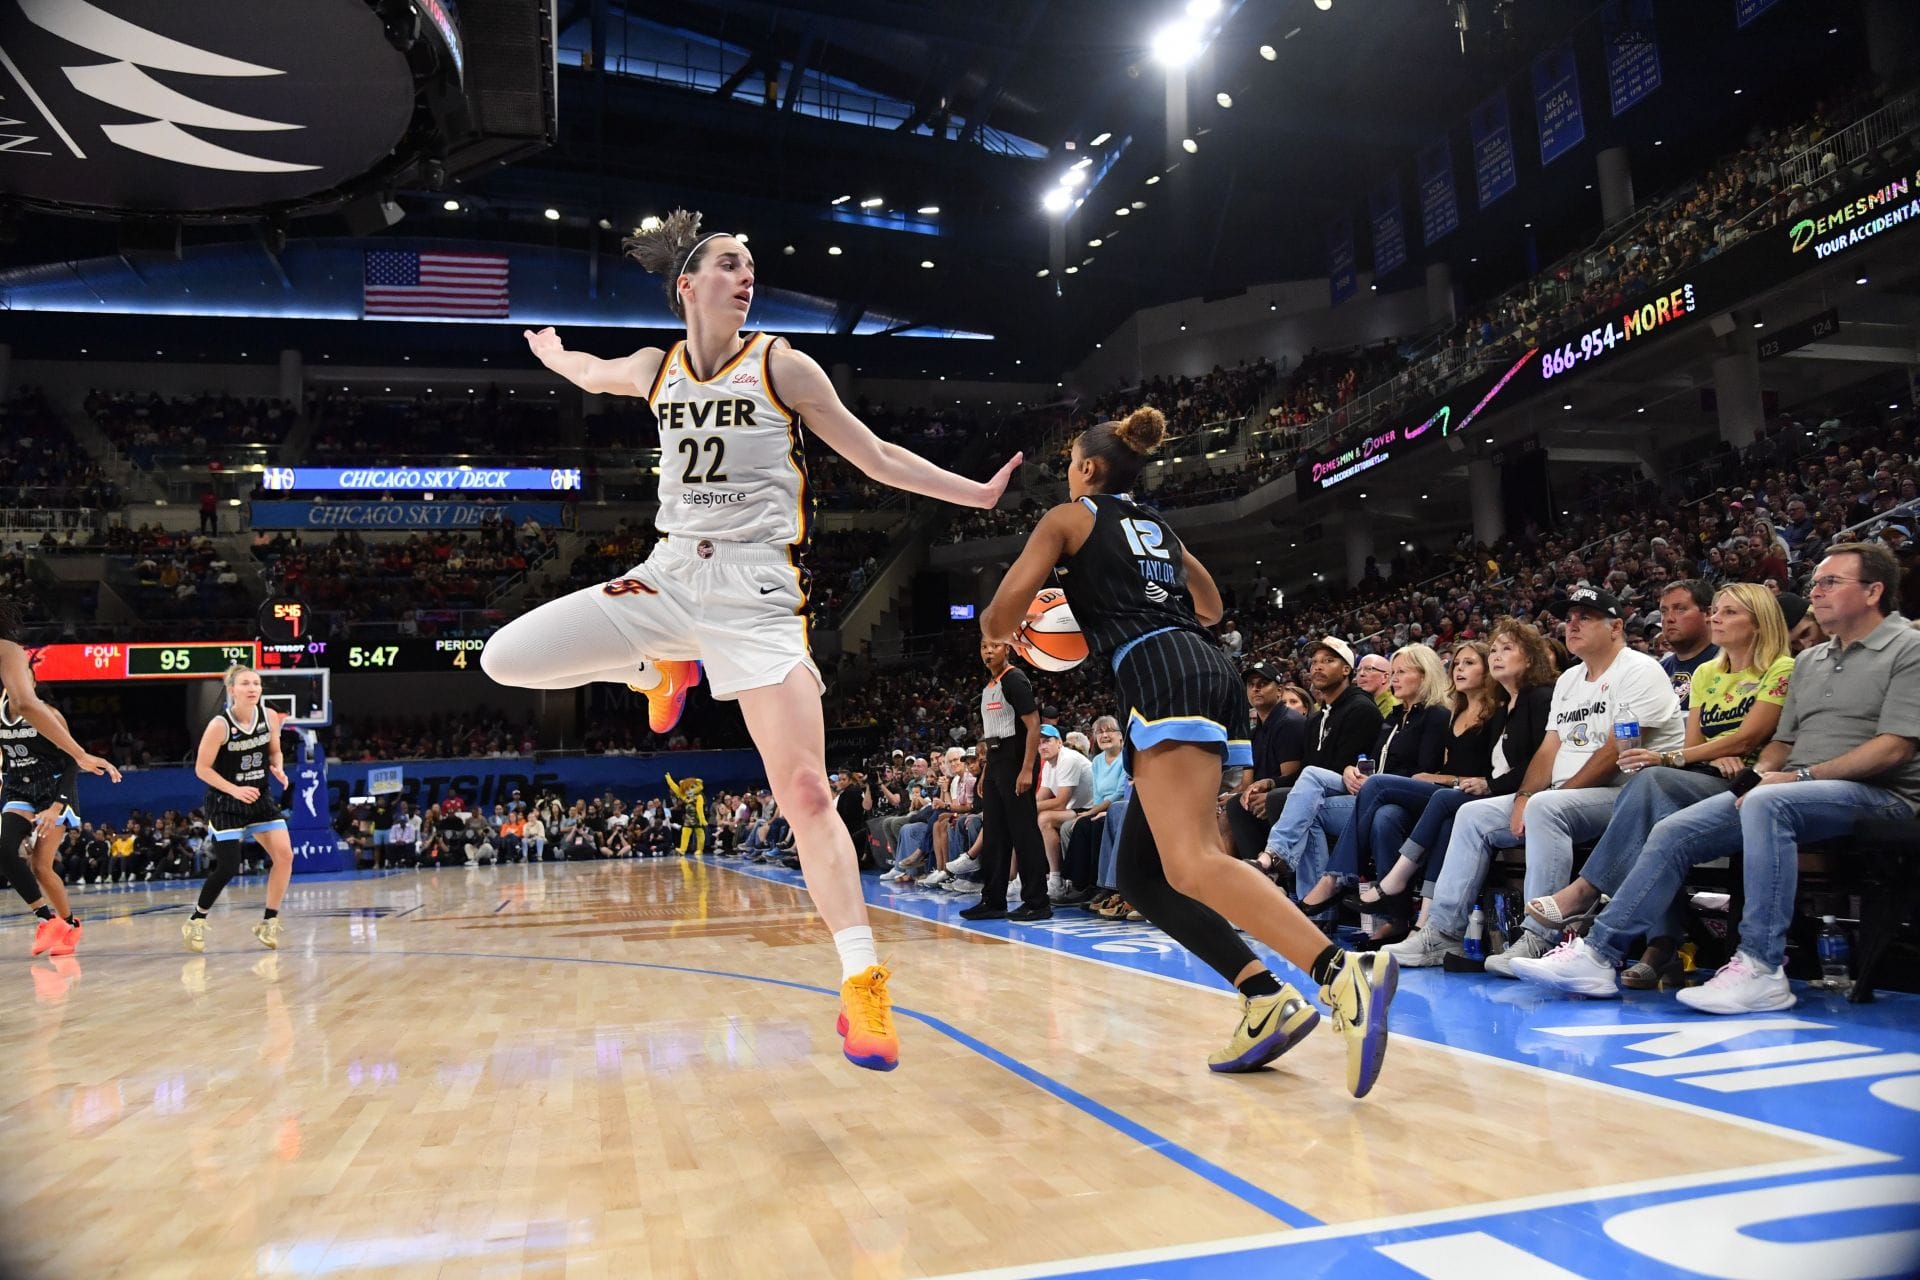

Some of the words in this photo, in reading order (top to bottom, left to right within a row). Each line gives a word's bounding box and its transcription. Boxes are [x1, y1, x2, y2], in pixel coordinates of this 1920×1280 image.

[1546, 90, 1568, 112] NCAA
[1544, 103, 1565, 124] SWEET
[1542, 288, 1686, 379] 866-954-MORE
[1811, 320, 1831, 337] 124
[1761, 341, 1779, 357] 123
[732, 373, 759, 387] Lilly
[658, 399, 757, 430] FEVER
[678, 436, 728, 484] 22
[339, 470, 422, 488] CHICAGO
[423, 470, 461, 487] SKY
[464, 470, 510, 488] DECK
[682, 490, 746, 508] salesforce
[308, 504, 404, 525] CHICAGO
[406, 504, 449, 524] SKY
[452, 503, 511, 524] DECK
[1120, 517, 1170, 559] 12
[1138, 560, 1176, 584] TAYLOR
[284, 616, 299, 637] 7
[84, 646, 121, 657] FOUL
[222, 647, 248, 659] TOL
[435, 640, 484, 651] PERIOD
[95, 658, 109, 668] 01
[160, 650, 190, 671] 95
[349, 646, 399, 667] 5:47
[453, 650, 467, 669] 4
[241, 752, 262, 771] 22
